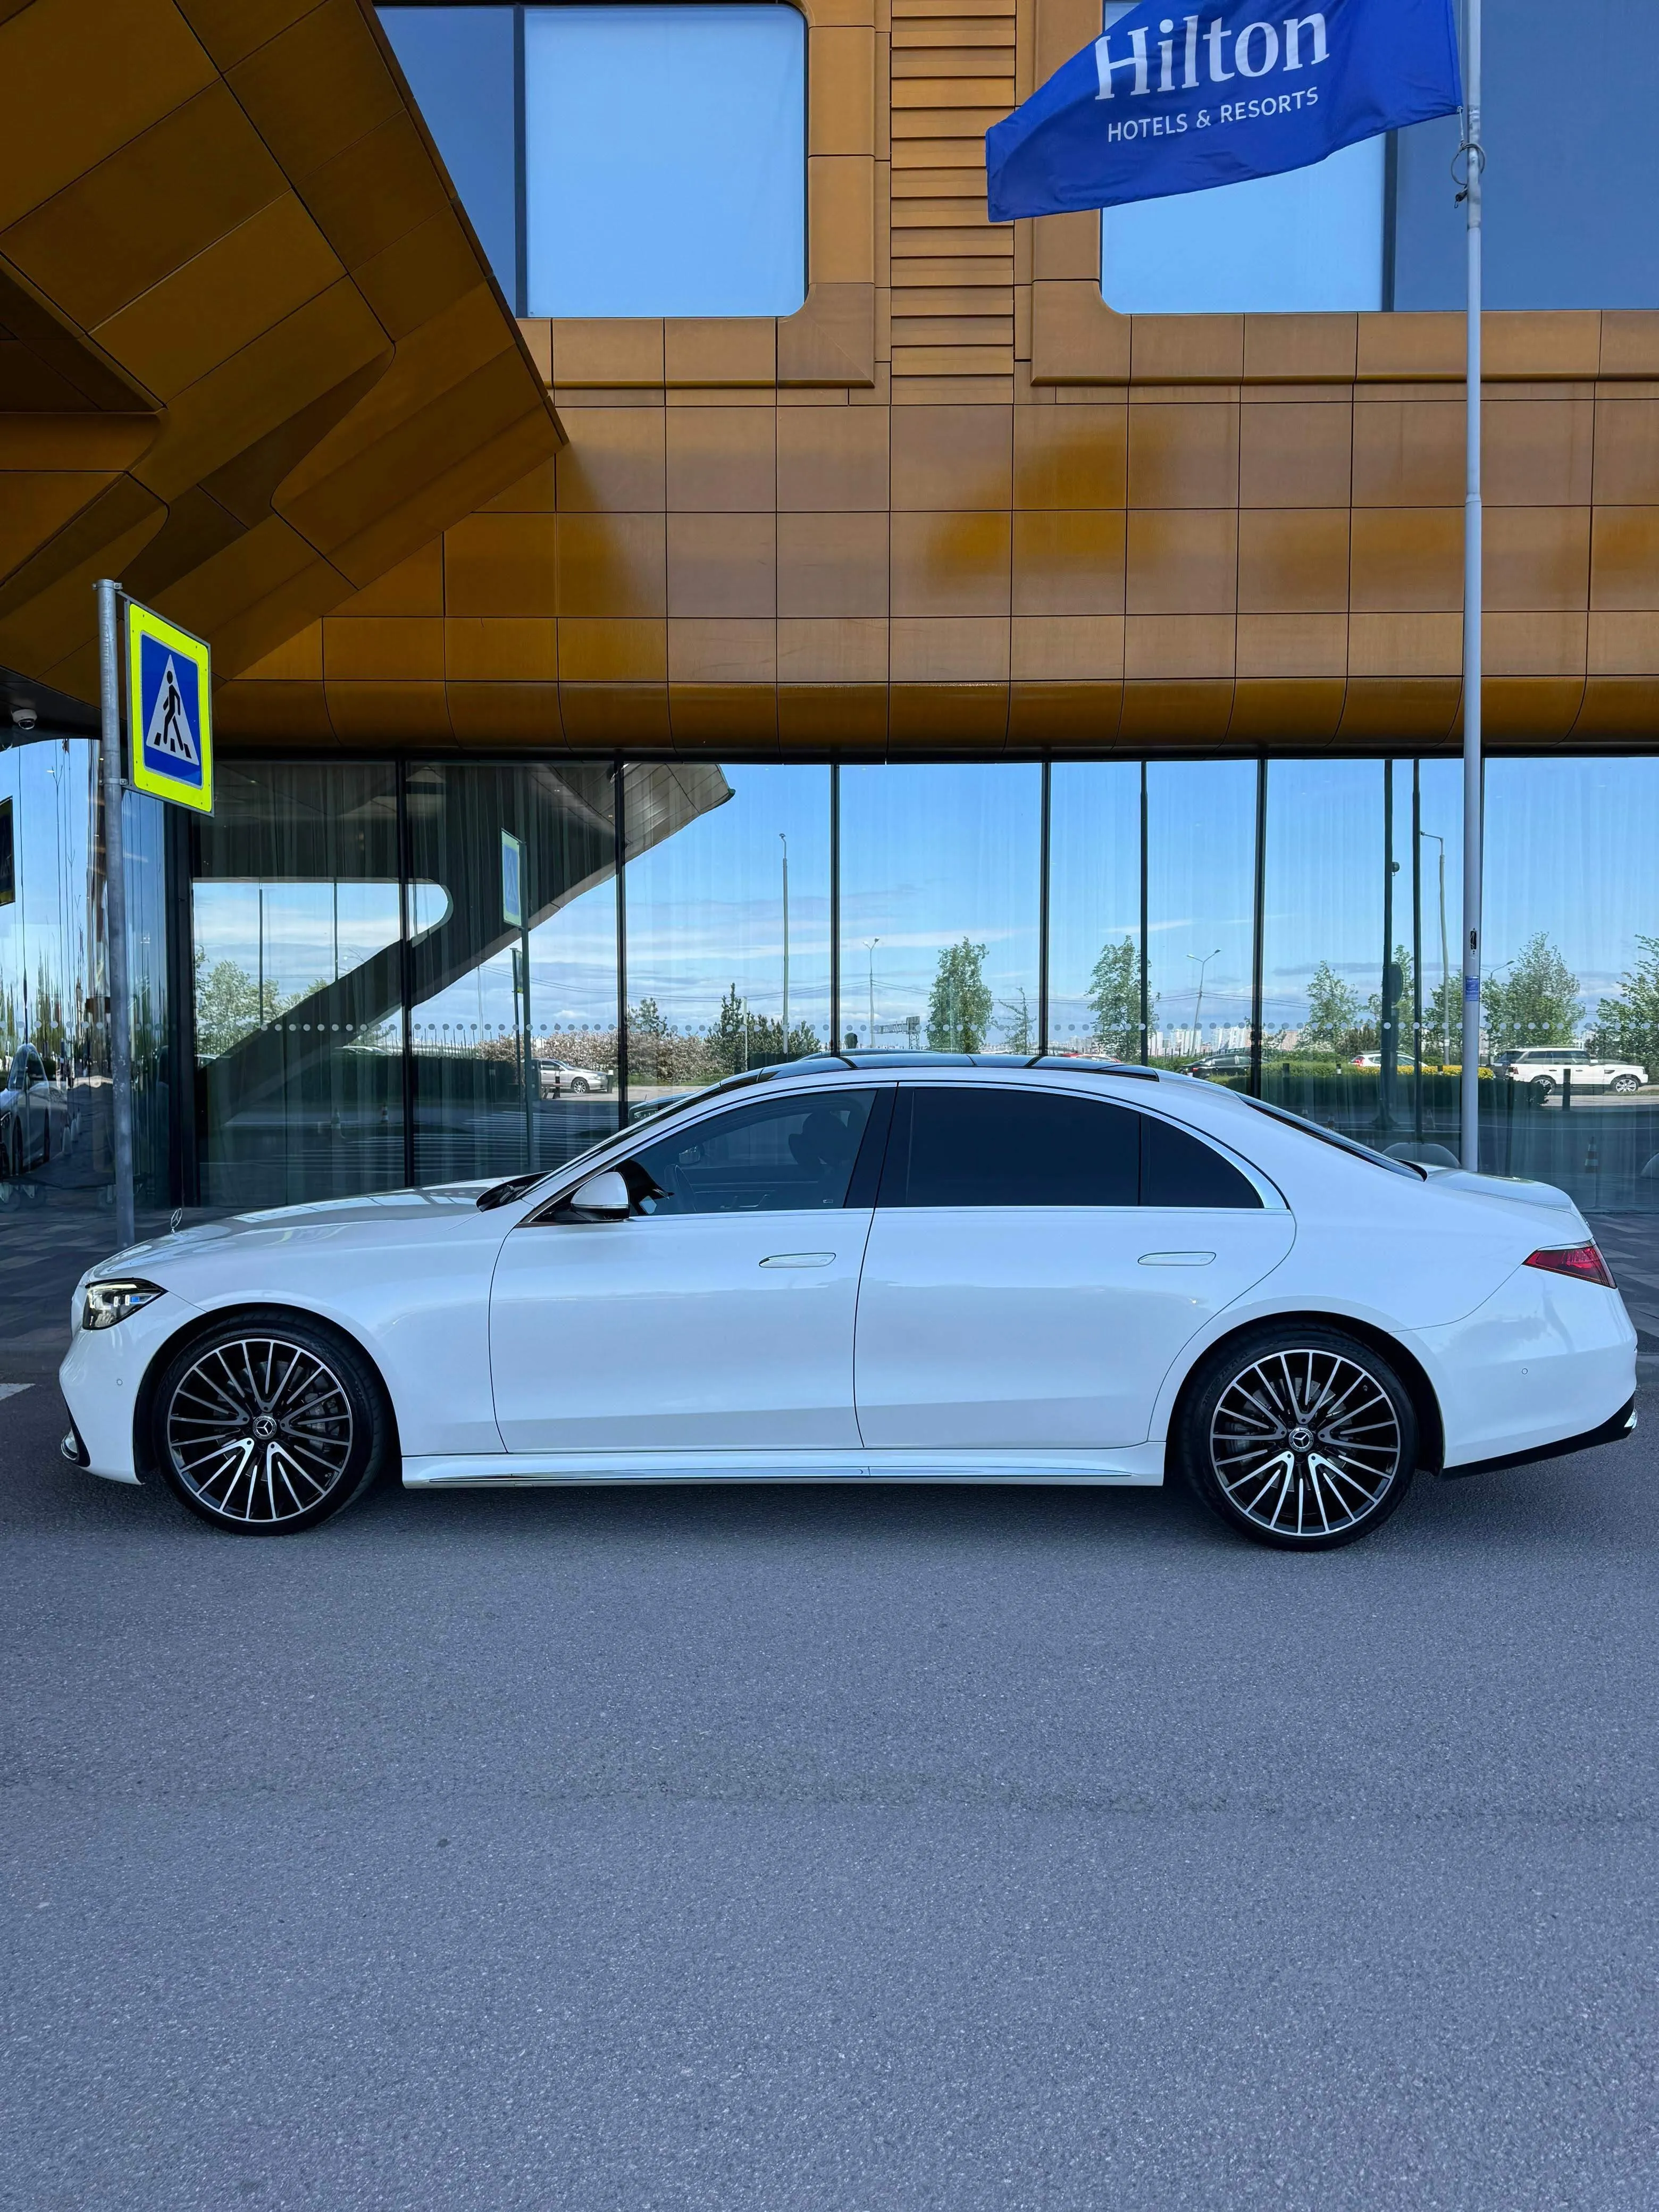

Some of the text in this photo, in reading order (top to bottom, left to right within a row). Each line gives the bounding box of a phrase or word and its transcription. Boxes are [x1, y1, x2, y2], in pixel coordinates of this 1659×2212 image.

[1094, 12, 1330, 100] Hilton
[1108, 86, 1319, 143] HOTELS & RESORTS
